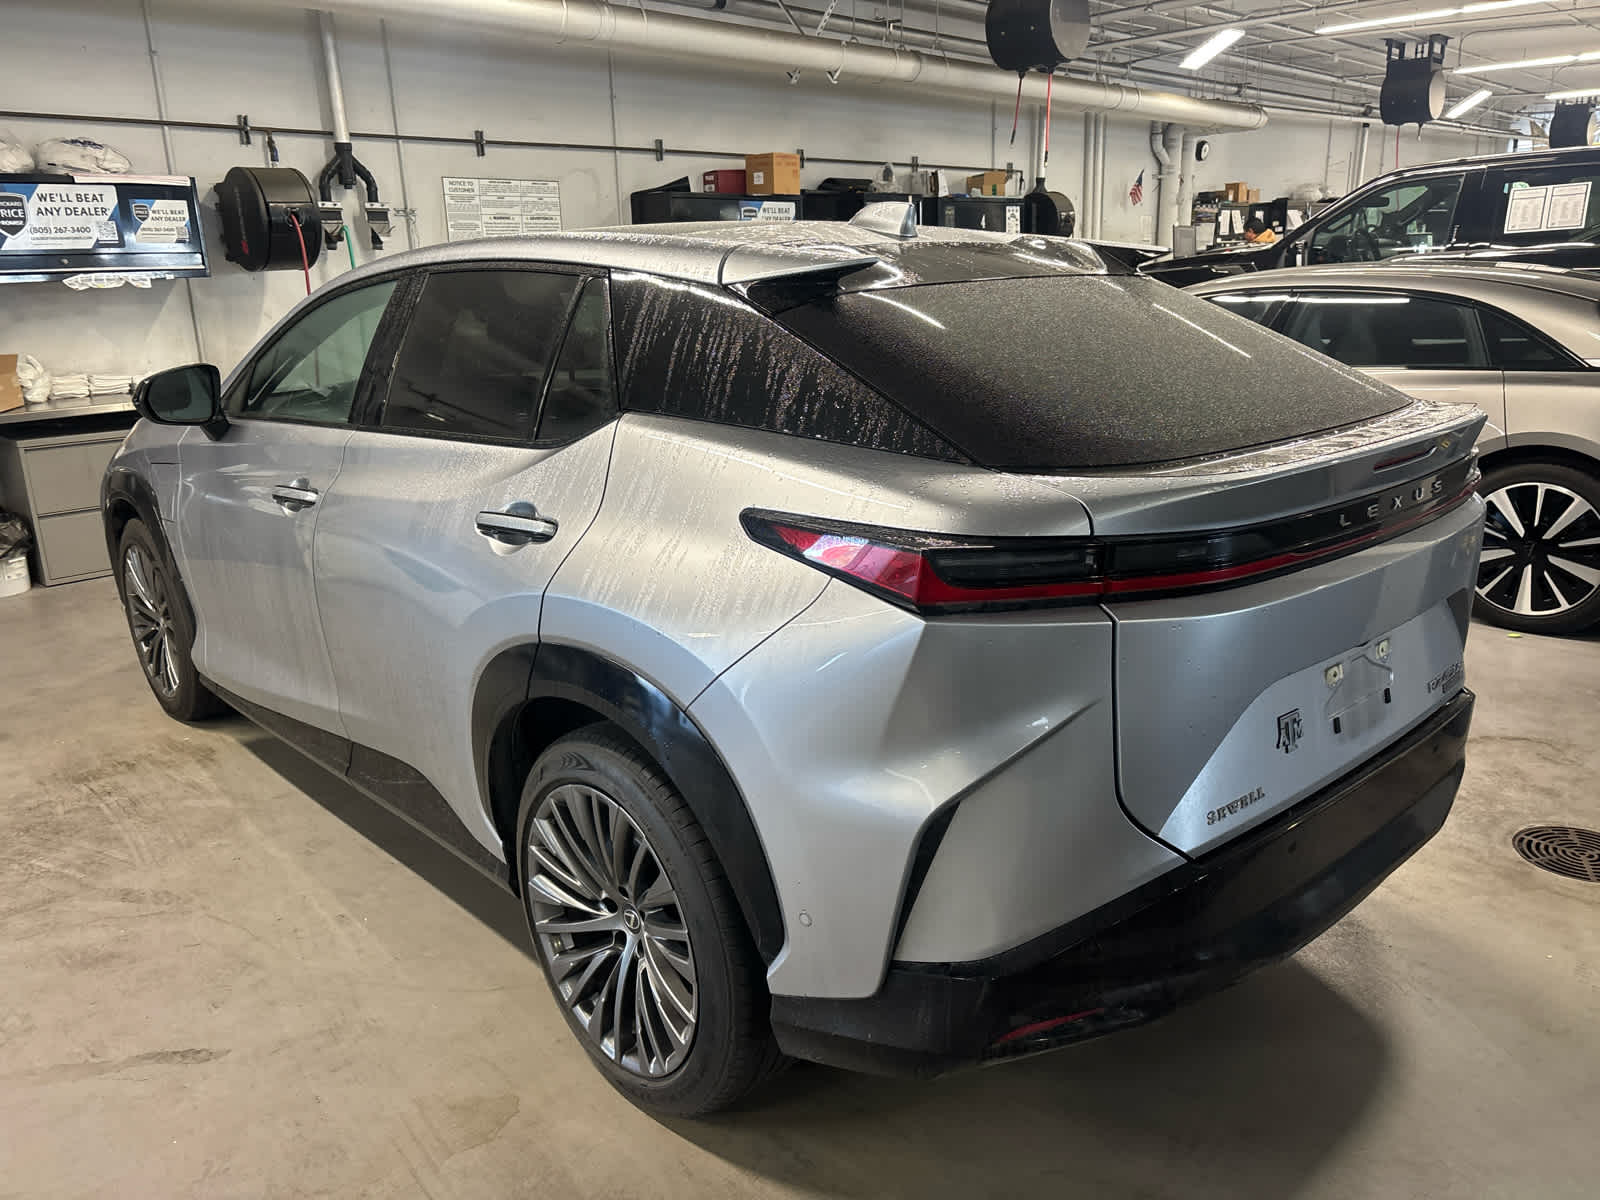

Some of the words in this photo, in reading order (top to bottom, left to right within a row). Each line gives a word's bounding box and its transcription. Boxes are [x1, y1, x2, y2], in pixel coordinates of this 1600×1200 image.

[36, 192, 73, 203] WE'LL
[75, 193, 105, 203] BEAT
[0, 209, 25, 217] RICE
[36, 207, 61, 216] ANY
[29, 226, 52, 235] (805)
[1338, 479, 1443, 528] LEXUS
[1206, 786, 1266, 826] SEWELL
